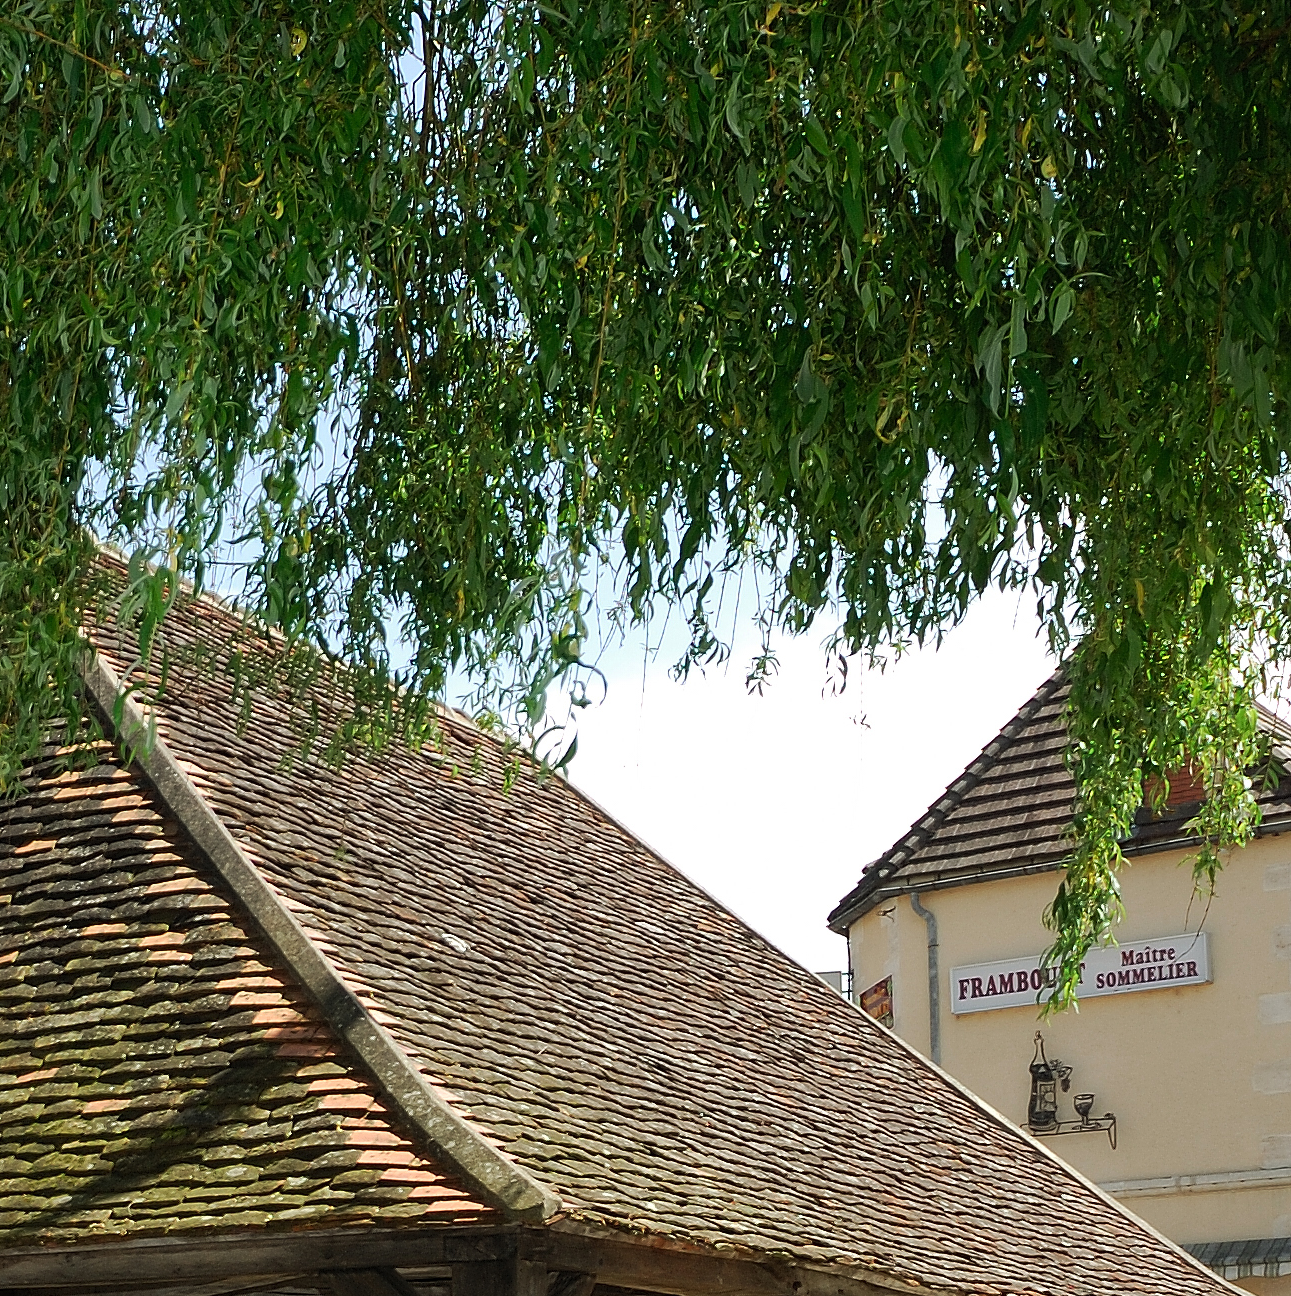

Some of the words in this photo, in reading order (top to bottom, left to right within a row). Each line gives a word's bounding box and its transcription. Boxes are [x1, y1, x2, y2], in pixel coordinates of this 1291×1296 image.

[1121, 945, 1177, 967] Maître
[958, 962, 1086, 1001] FRAMBOUT
[1096, 960, 1199, 990] SOMMELIER
